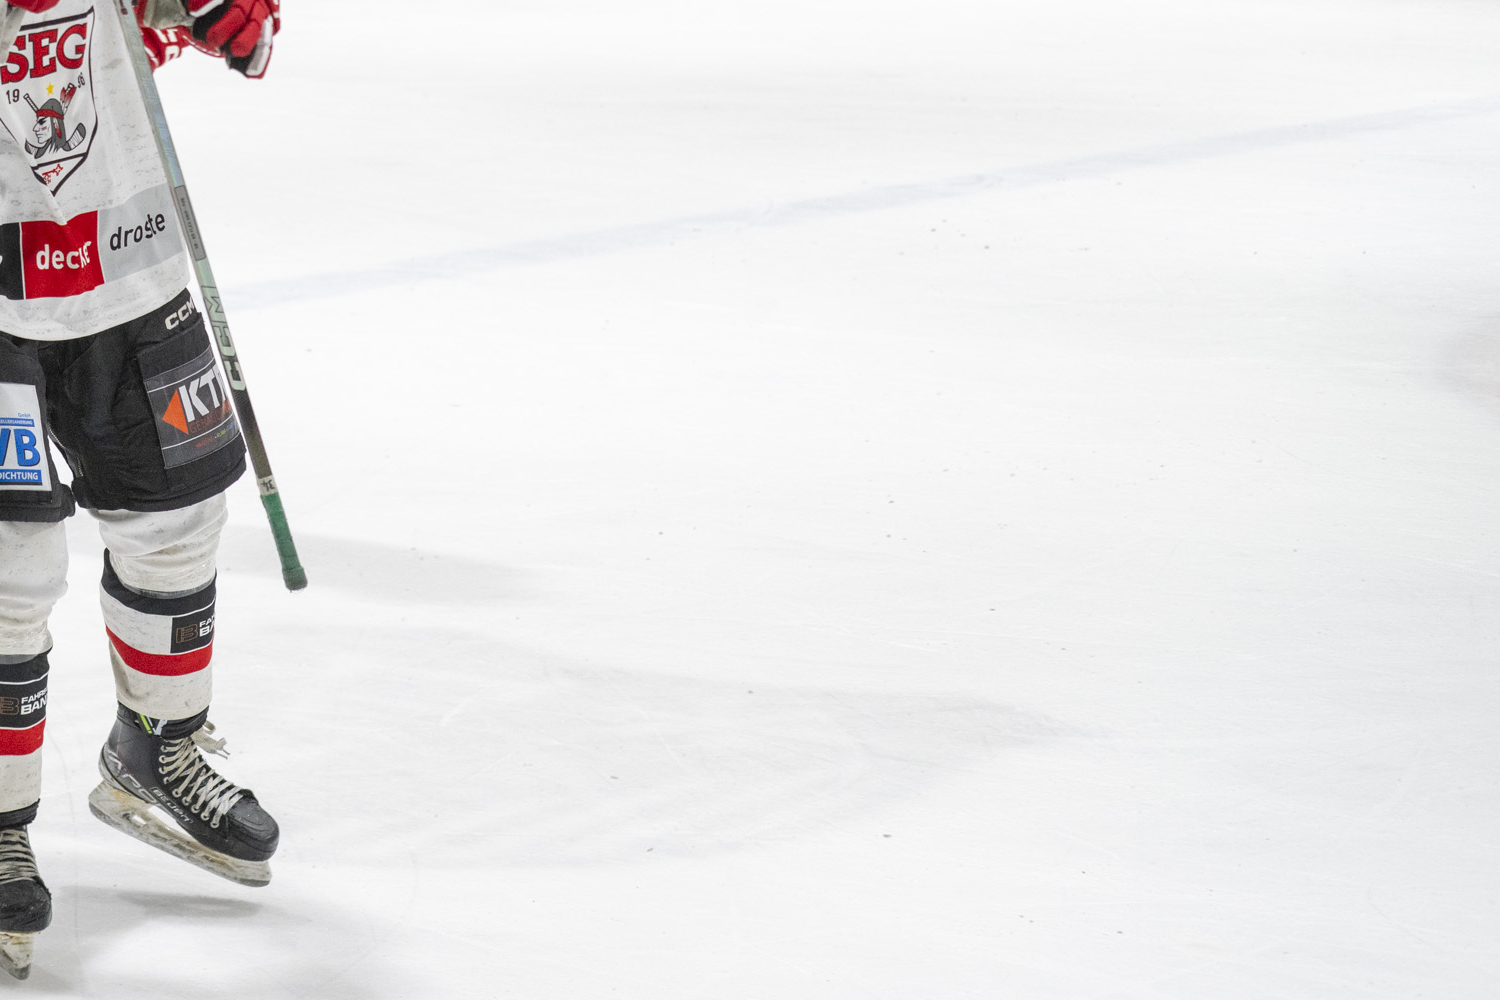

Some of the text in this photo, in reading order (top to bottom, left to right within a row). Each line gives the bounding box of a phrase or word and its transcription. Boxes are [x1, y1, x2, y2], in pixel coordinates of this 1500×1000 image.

[0, 22, 88, 85] SEG
[6, 88, 20, 105] 19
[109, 213, 167, 252] droste
[164, 300, 196, 331] CCM
[200, 285, 247, 391] CCM
